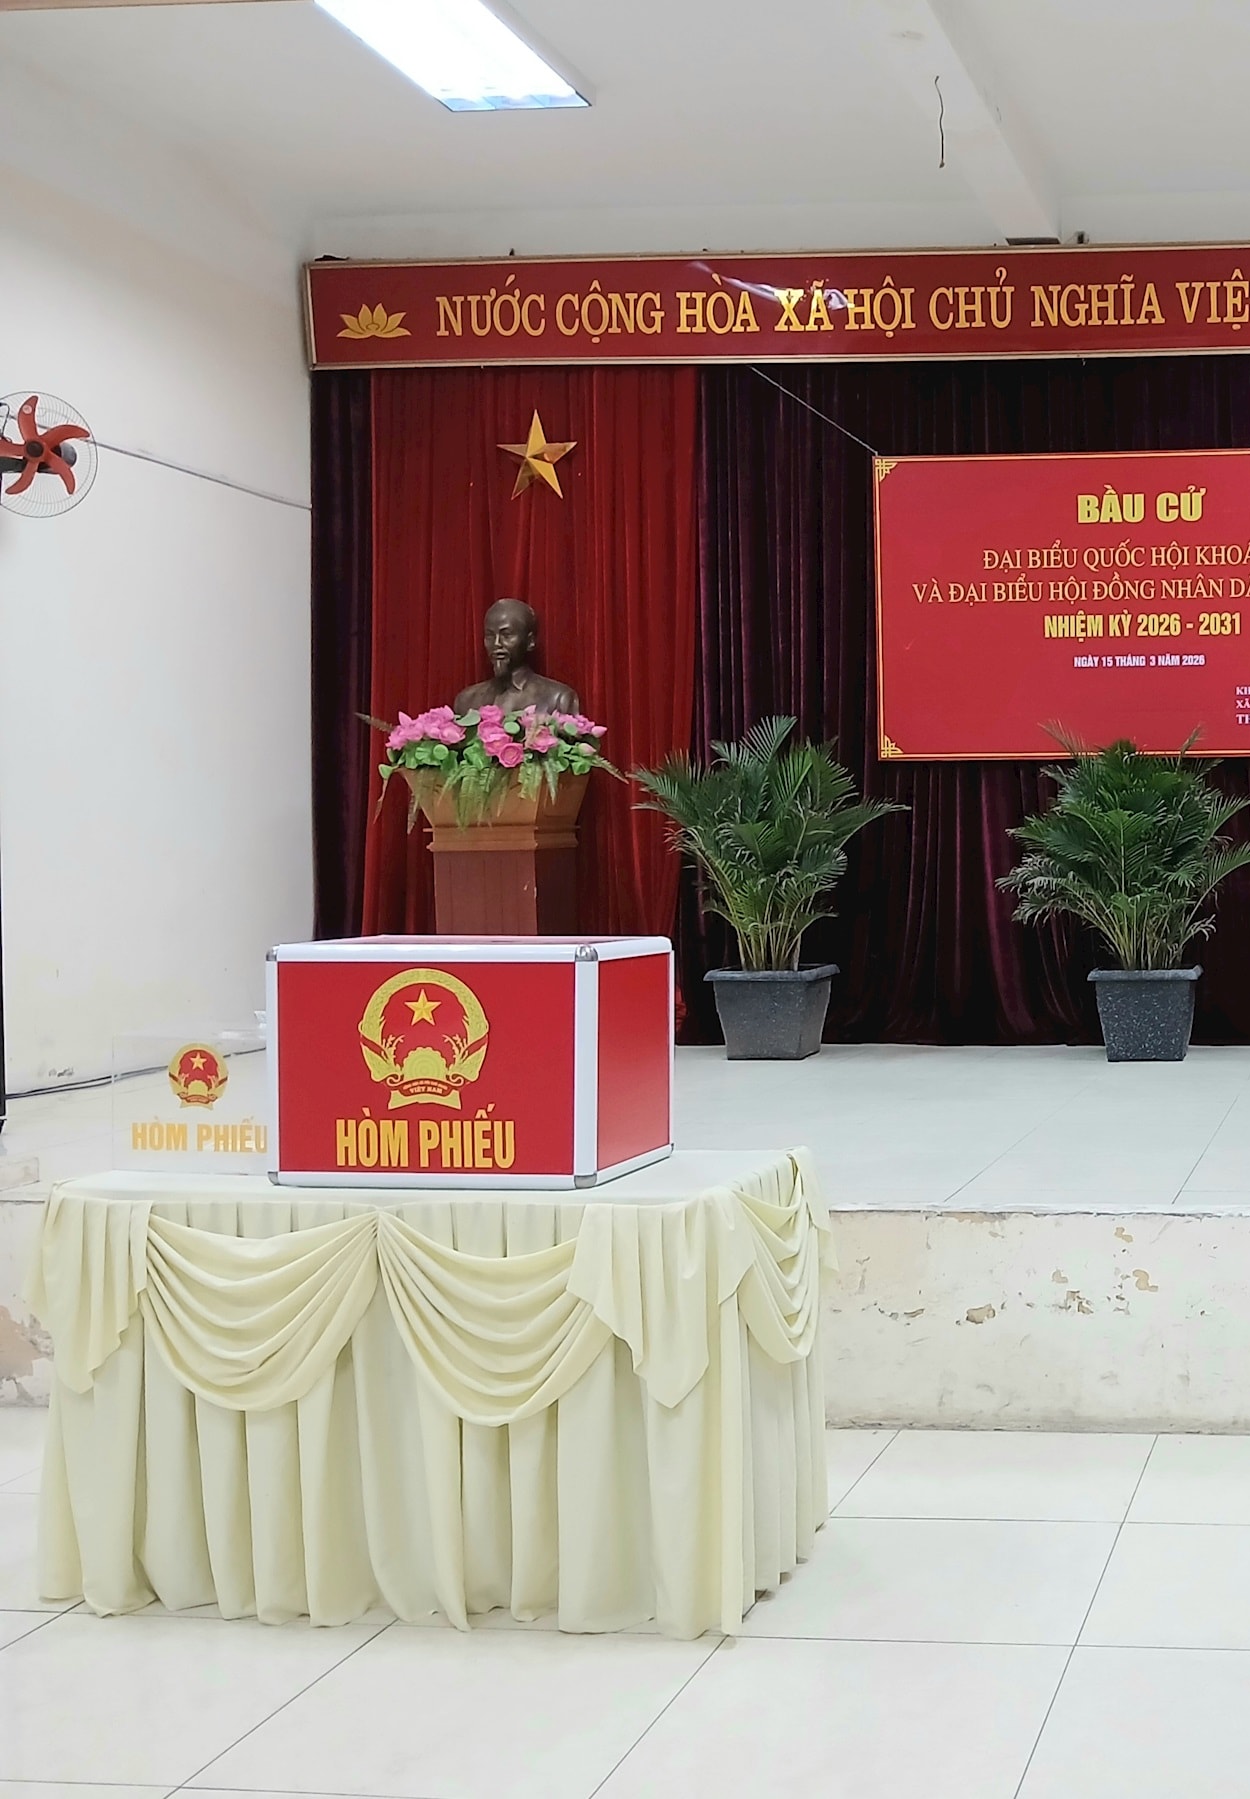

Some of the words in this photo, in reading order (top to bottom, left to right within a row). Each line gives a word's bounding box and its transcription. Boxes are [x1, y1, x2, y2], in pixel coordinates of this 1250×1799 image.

[436, 273, 546, 337] NƯỚC
[555, 279, 666, 343] CỘNG
[676, 272, 760, 334] HÒA
[775, 278, 835, 332] XÃ
[846, 275, 916, 337] HỘI
[928, 266, 1015, 329] CHỦ
[1030, 273, 1166, 328] NGHĨA
[1077, 484, 1145, 524] BẦU
[1156, 485, 1206, 522] CỬ
[983, 549, 1022, 573] ĐẠI
[1027, 539, 1078, 569] BIỂU
[1083, 538, 1146, 572] QUỐC
[1150, 540, 1189, 570] HỘI
[912, 577, 944, 604] VÀ
[948, 582, 988, 606] ĐẠI
[992, 573, 1043, 602] BIỂU
[1049, 575, 1088, 605] HỘI
[1092, 571, 1156, 600] ĐỒNG
[1160, 573, 1224, 599] NHÂN
[1044, 610, 1103, 643] NHIỆM
[1108, 610, 1132, 637] KỲ
[1137, 615, 1181, 637] 2026
[1198, 612, 1241, 635] 2031
[1073, 654, 1099, 667] NGÀY
[1101, 656, 1113, 667] 15
[1115, 653, 1146, 667] THÁNG
[1149, 655, 1156, 666] 3
[1157, 653, 1180, 666] NĂM
[1182, 655, 1206, 665] 2026
[1236, 698, 1250, 709] XÃ
[132, 1115, 187, 1152] HÒM
[196, 1115, 268, 1153] PHIẾU
[336, 1107, 409, 1167] HÒM
[418, 1103, 515, 1168] PHIẾU
